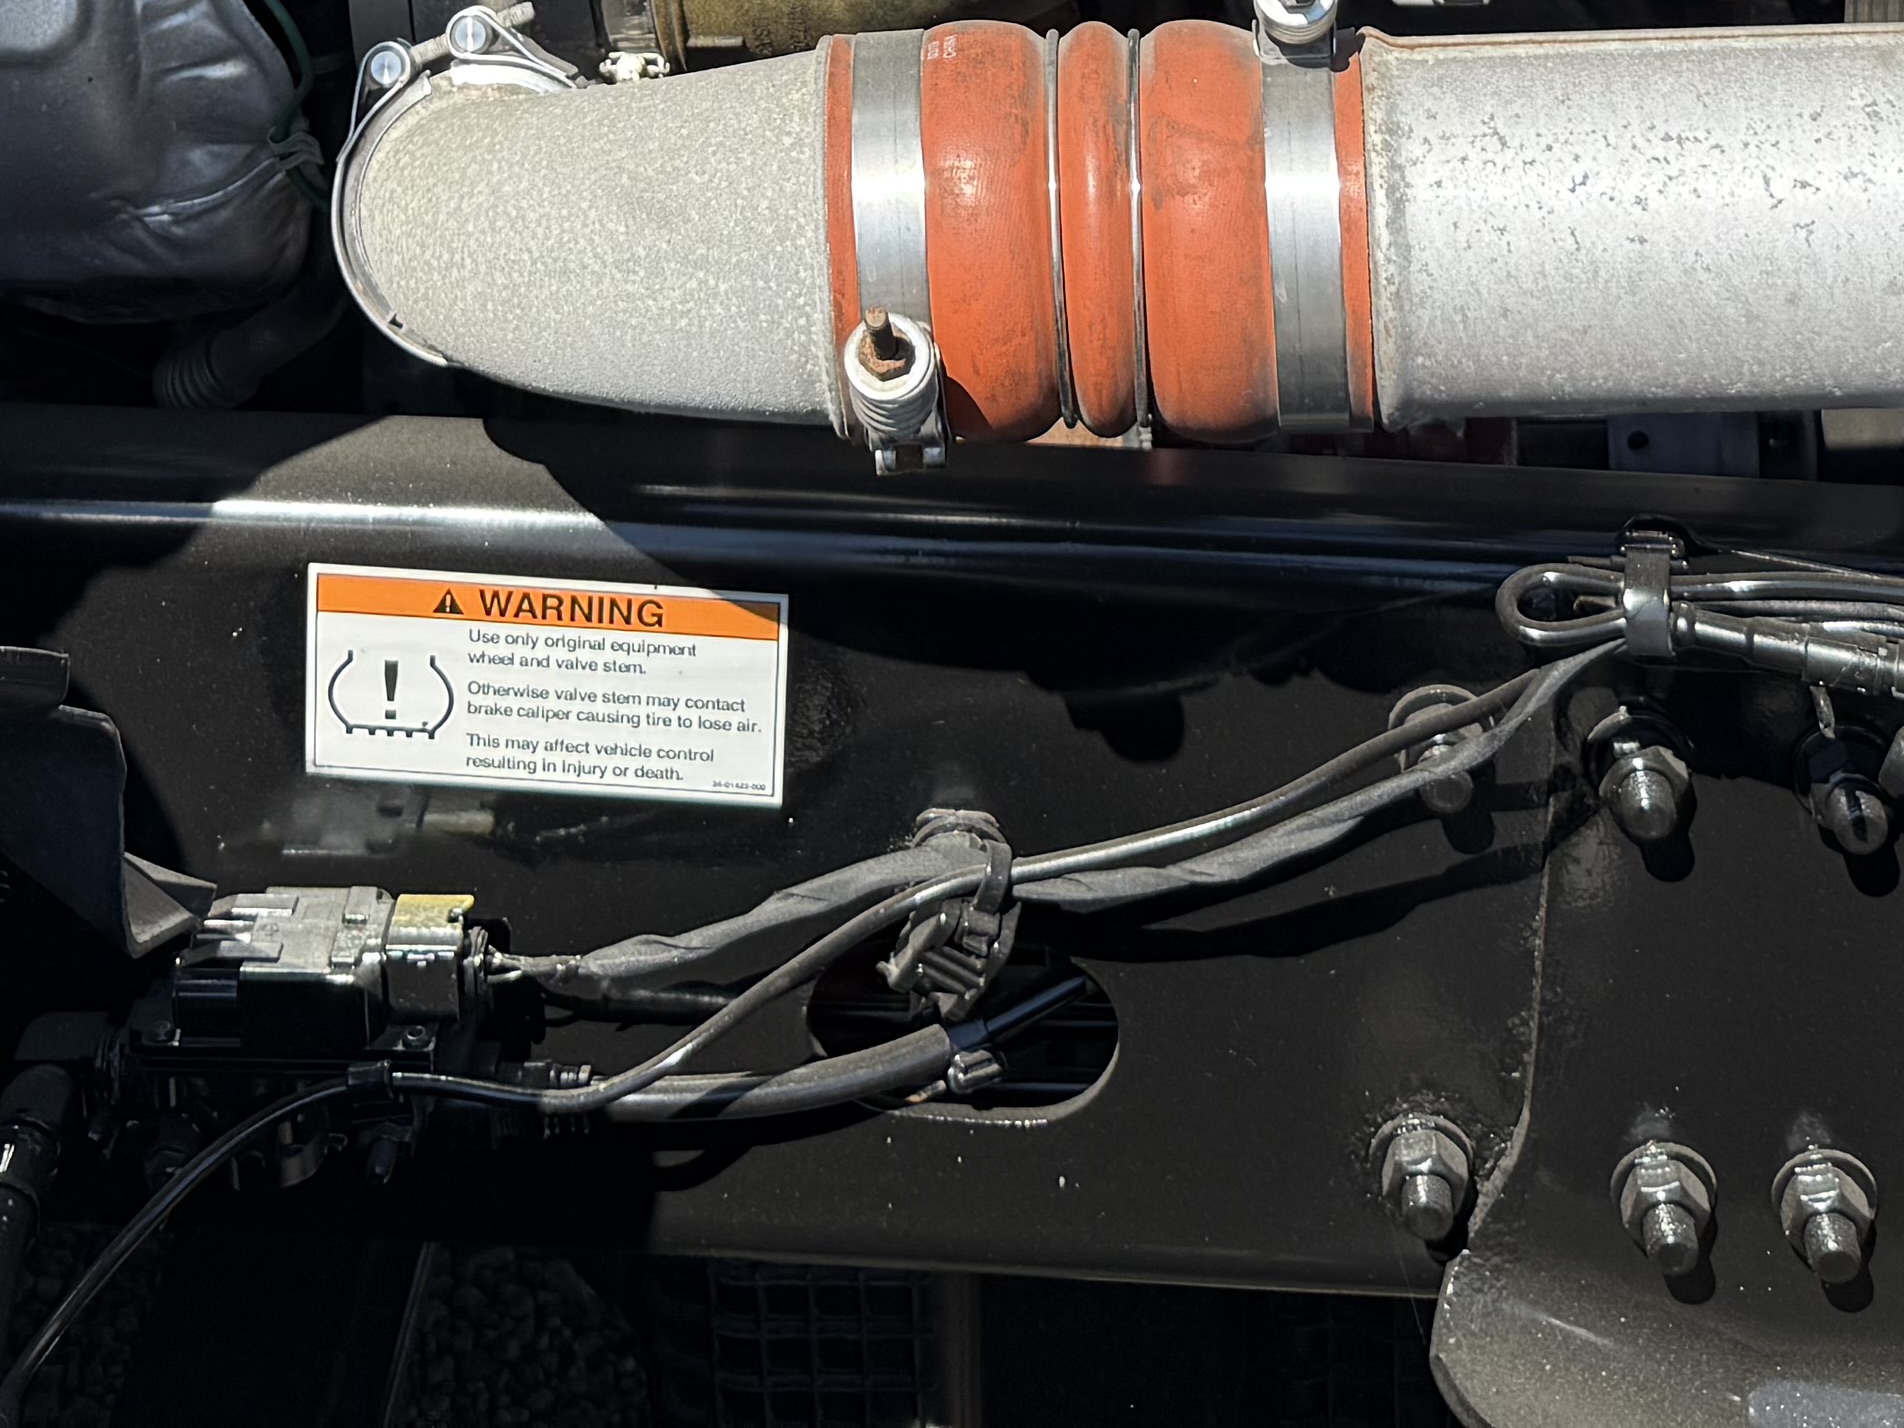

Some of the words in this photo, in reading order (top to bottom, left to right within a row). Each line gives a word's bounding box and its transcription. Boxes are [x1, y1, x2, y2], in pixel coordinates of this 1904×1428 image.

[479, 589, 665, 628] WARNING
[468, 629, 500, 646] Use
[504, 633, 540, 652] only
[544, 636, 606, 653] original
[610, 639, 697, 659] equipment
[468, 651, 515, 667] wheel
[519, 653, 550, 668] and
[555, 656, 599, 673] valve
[603, 660, 646, 675] stem.
[467, 682, 549, 700] Otherwise
[554, 686, 597, 703] valve
[602, 689, 641, 705] stem
[646, 694, 681, 711] may
[685, 696, 746, 712] contact
[467, 702, 512, 717] brake
[517, 704, 571, 723] caliper
[576, 708, 640, 729] causing
[645, 712, 672, 728] tire
[677, 714, 693, 729] to
[697, 715, 732, 732] lose
[737, 718, 762, 733] air.
[466, 733, 500, 750] This
[505, 738, 539, 757] may
[544, 738, 590, 756] affect
[595, 741, 652, 760] vehicle
[657, 745, 714, 763] control
[466, 755, 536, 774] resulting
[541, 757, 556, 772] in
[612, 764, 630, 777] or
[634, 763, 684, 781] death.
